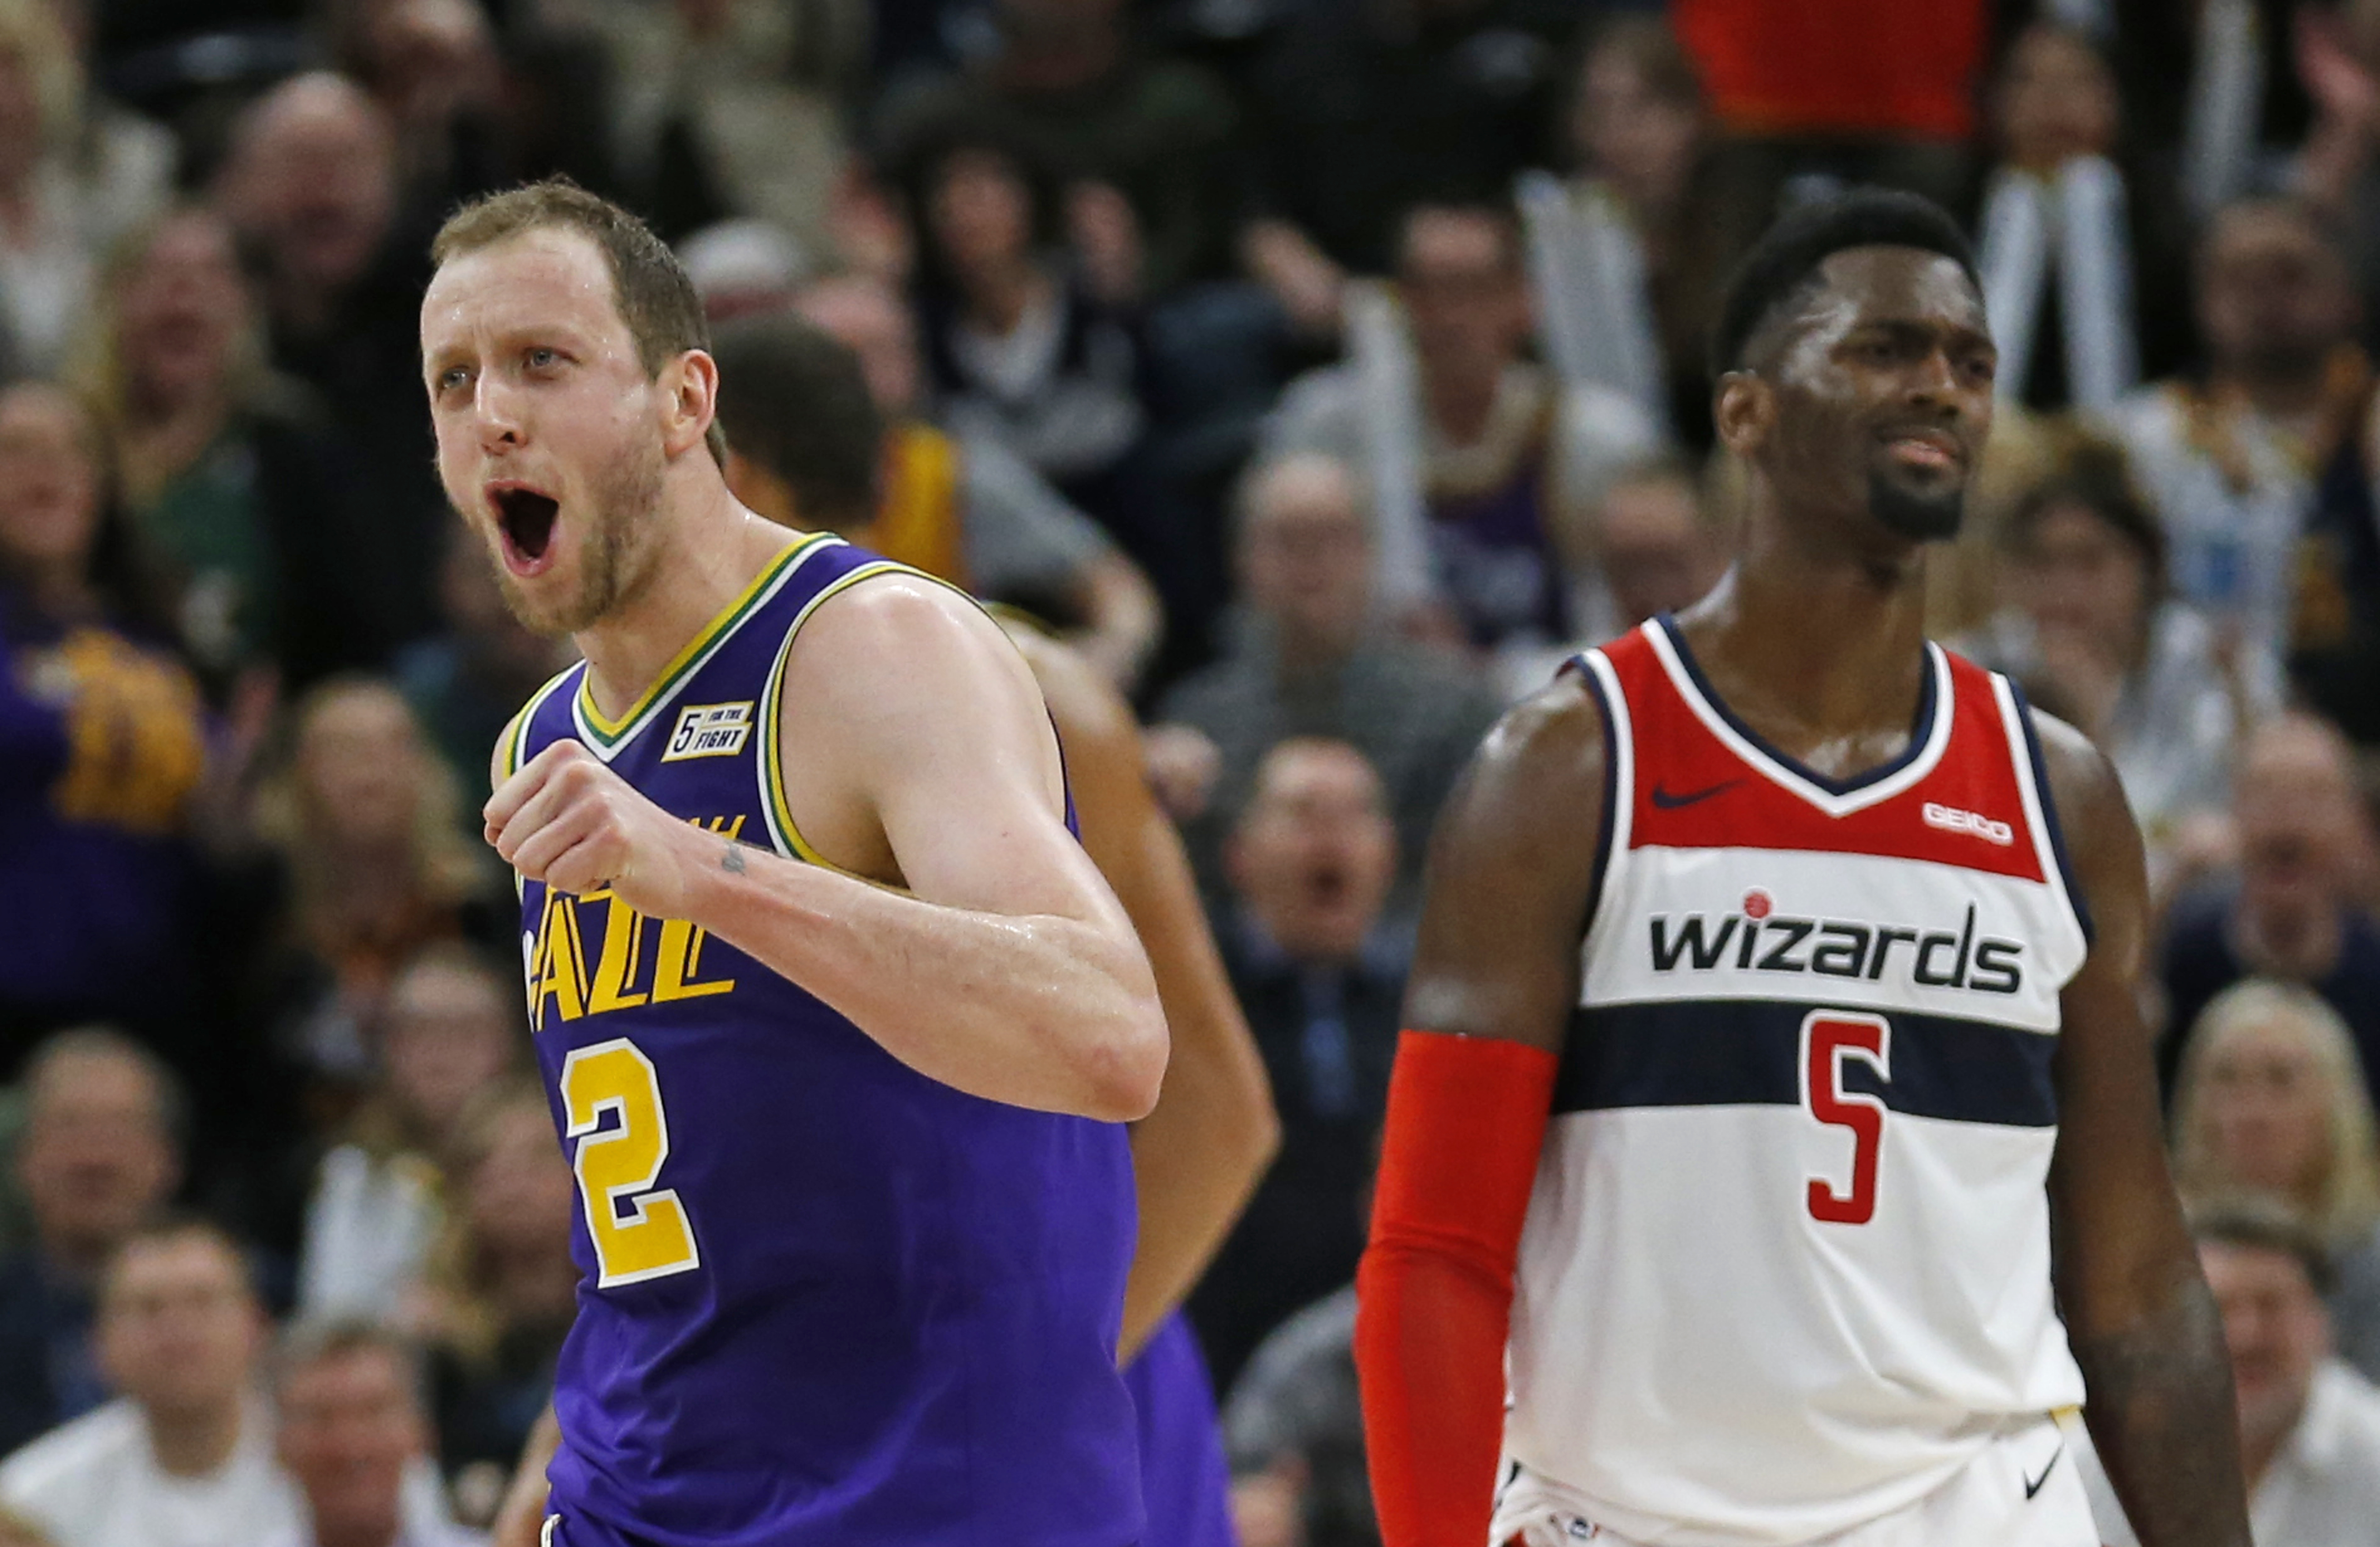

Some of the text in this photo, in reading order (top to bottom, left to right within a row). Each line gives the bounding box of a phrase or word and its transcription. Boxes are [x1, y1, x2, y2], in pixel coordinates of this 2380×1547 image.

[673, 713, 702, 753] 5
[693, 730, 742, 750] FIGHT
[1923, 802, 2014, 846] GEICO
[1649, 887, 2024, 994] wizards
[1799, 1009, 1891, 1225] 5
[560, 1037, 700, 1289] 2
